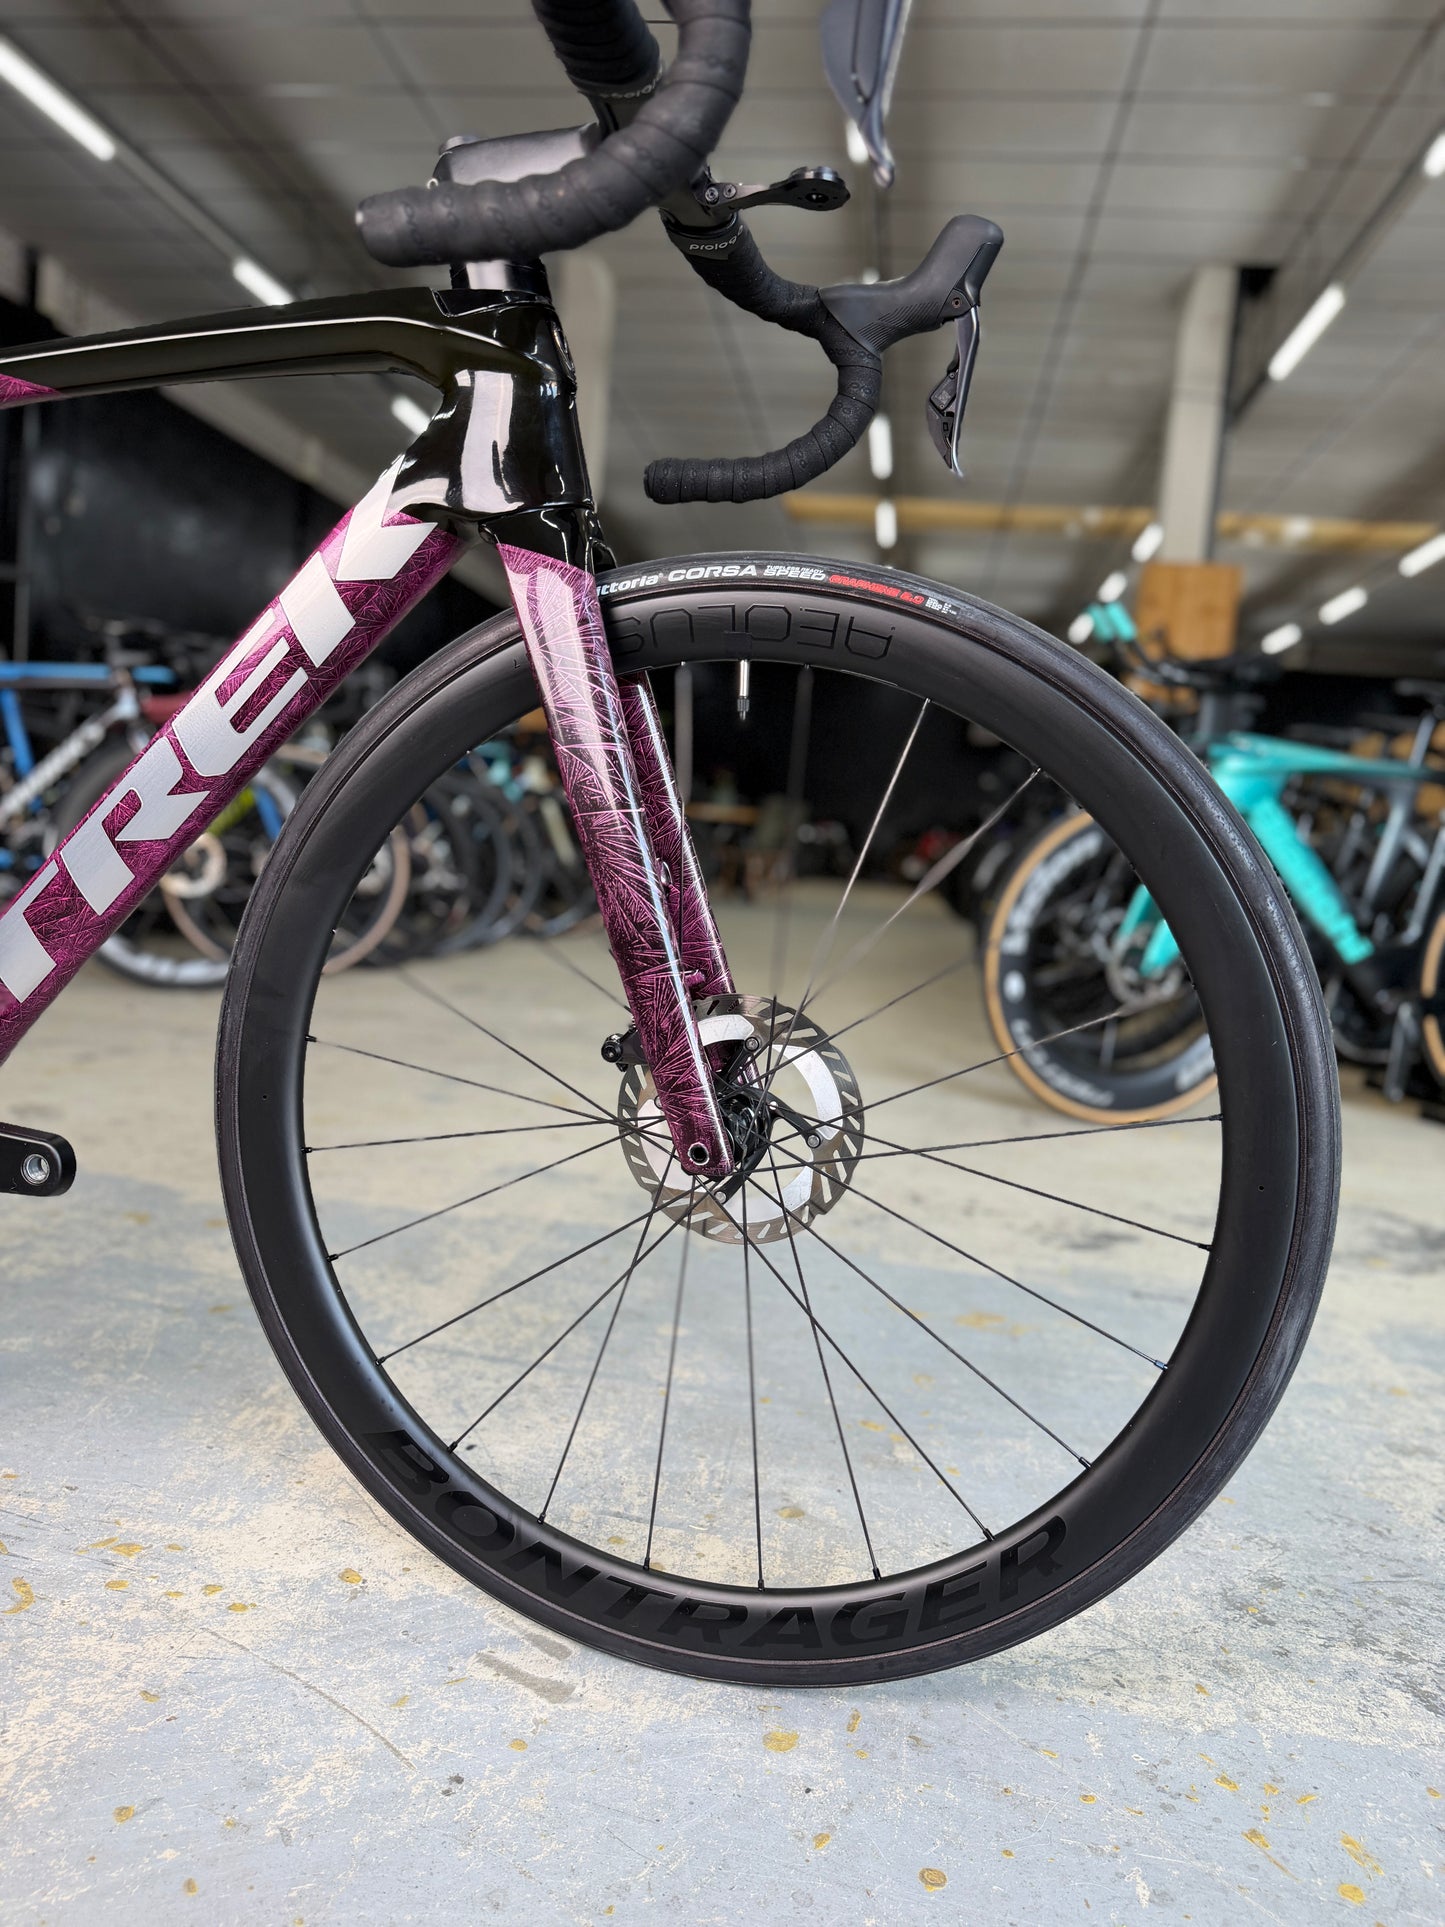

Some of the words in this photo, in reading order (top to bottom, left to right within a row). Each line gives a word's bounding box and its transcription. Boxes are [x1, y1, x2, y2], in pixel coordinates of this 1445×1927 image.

[596, 575, 659, 597] ittoria
[667, 564, 758, 583] CORSA
[763, 569, 826, 581] SPEED
[0, 454, 438, 1003] TREK
[362, 1428, 1069, 1649] BONTRAGER
